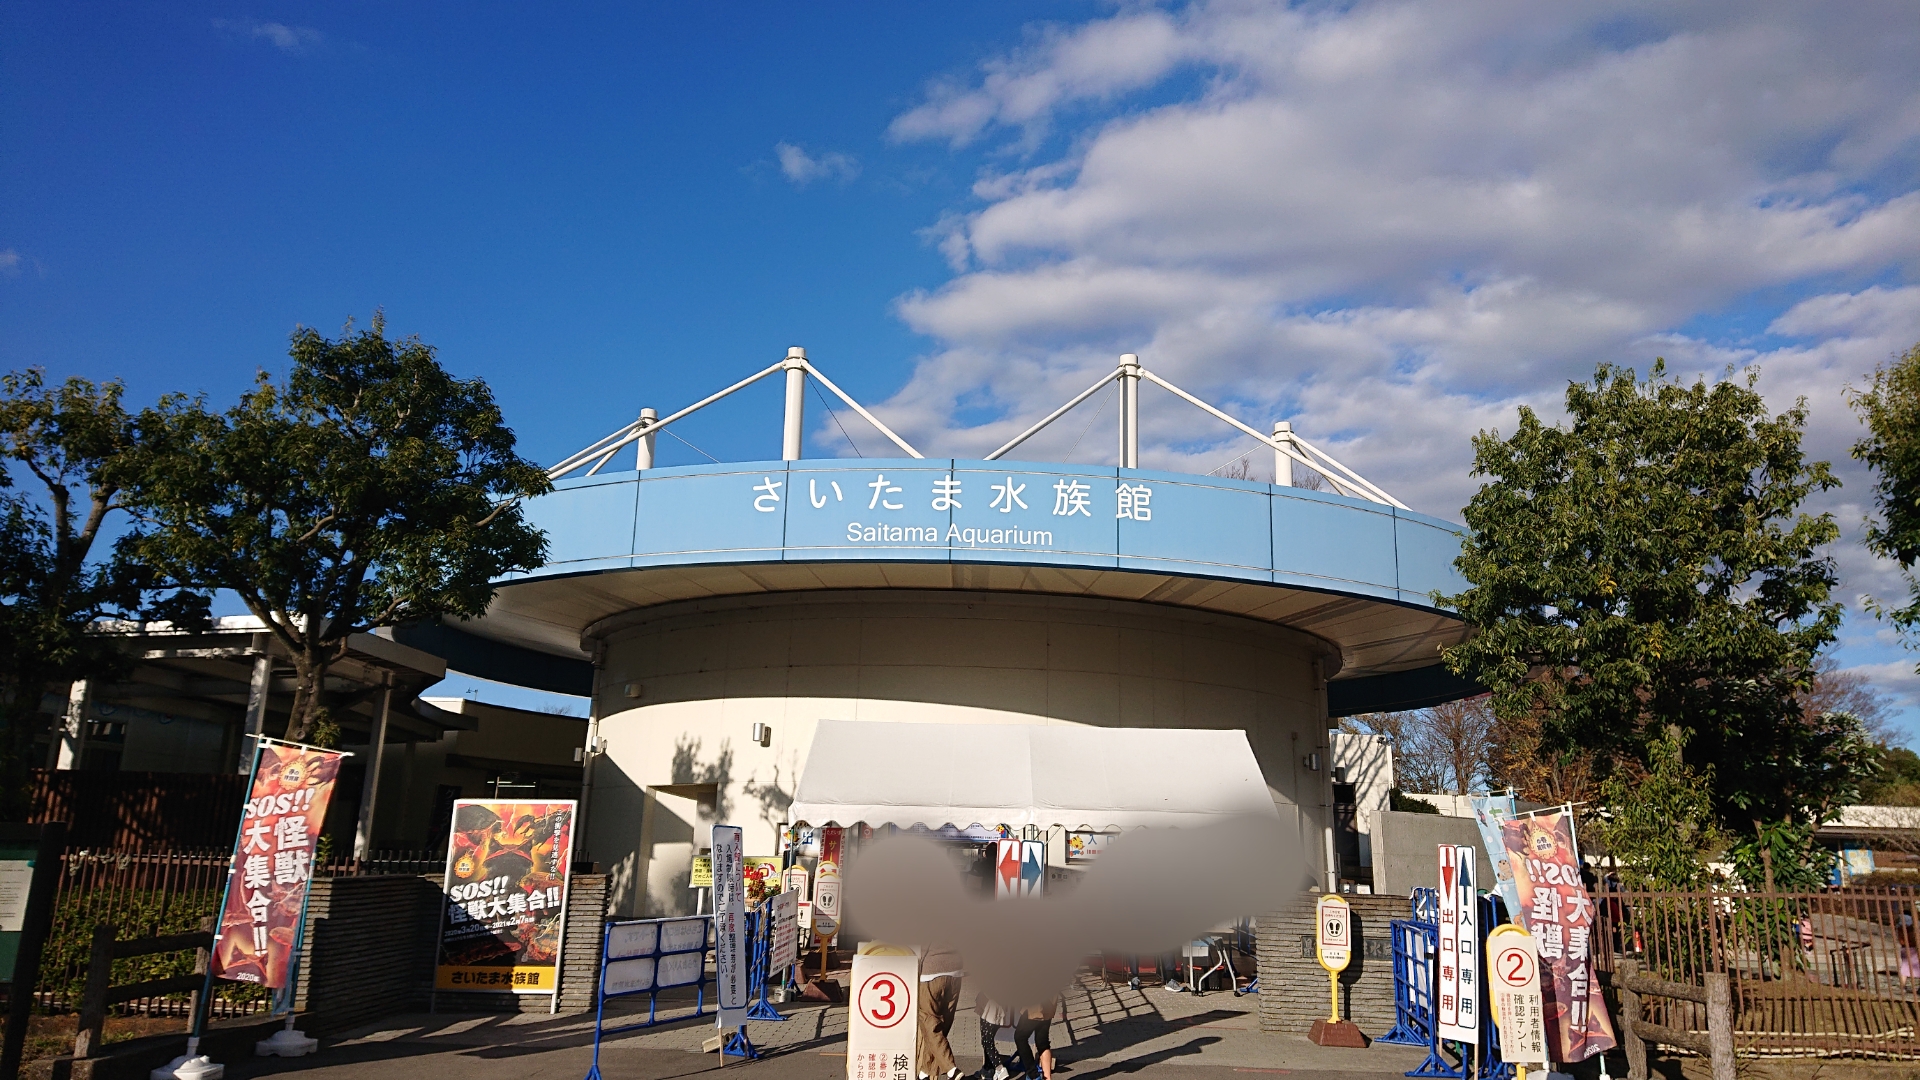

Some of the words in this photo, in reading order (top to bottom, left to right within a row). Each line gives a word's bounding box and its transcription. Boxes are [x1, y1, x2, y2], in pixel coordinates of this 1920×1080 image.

[752, 474, 1153, 522] さいたま水族館
[846, 522, 938, 543] Saitama
[946, 523, 1053, 548] Aquarium
[245, 787, 315, 819] SOS!!
[273, 815, 311, 885] 怪獣
[448, 886, 561, 925] 怪獣大集合!!
[450, 875, 509, 903] SOS!!
[451, 971, 540, 986] さいたま水族館
[1441, 908, 1455, 1011] 出口専用
[1460, 910, 1474, 1015] 入口専用
[1514, 993, 1527, 1052] 確認テント
[1529, 994, 1541, 1053] 利用者情報
